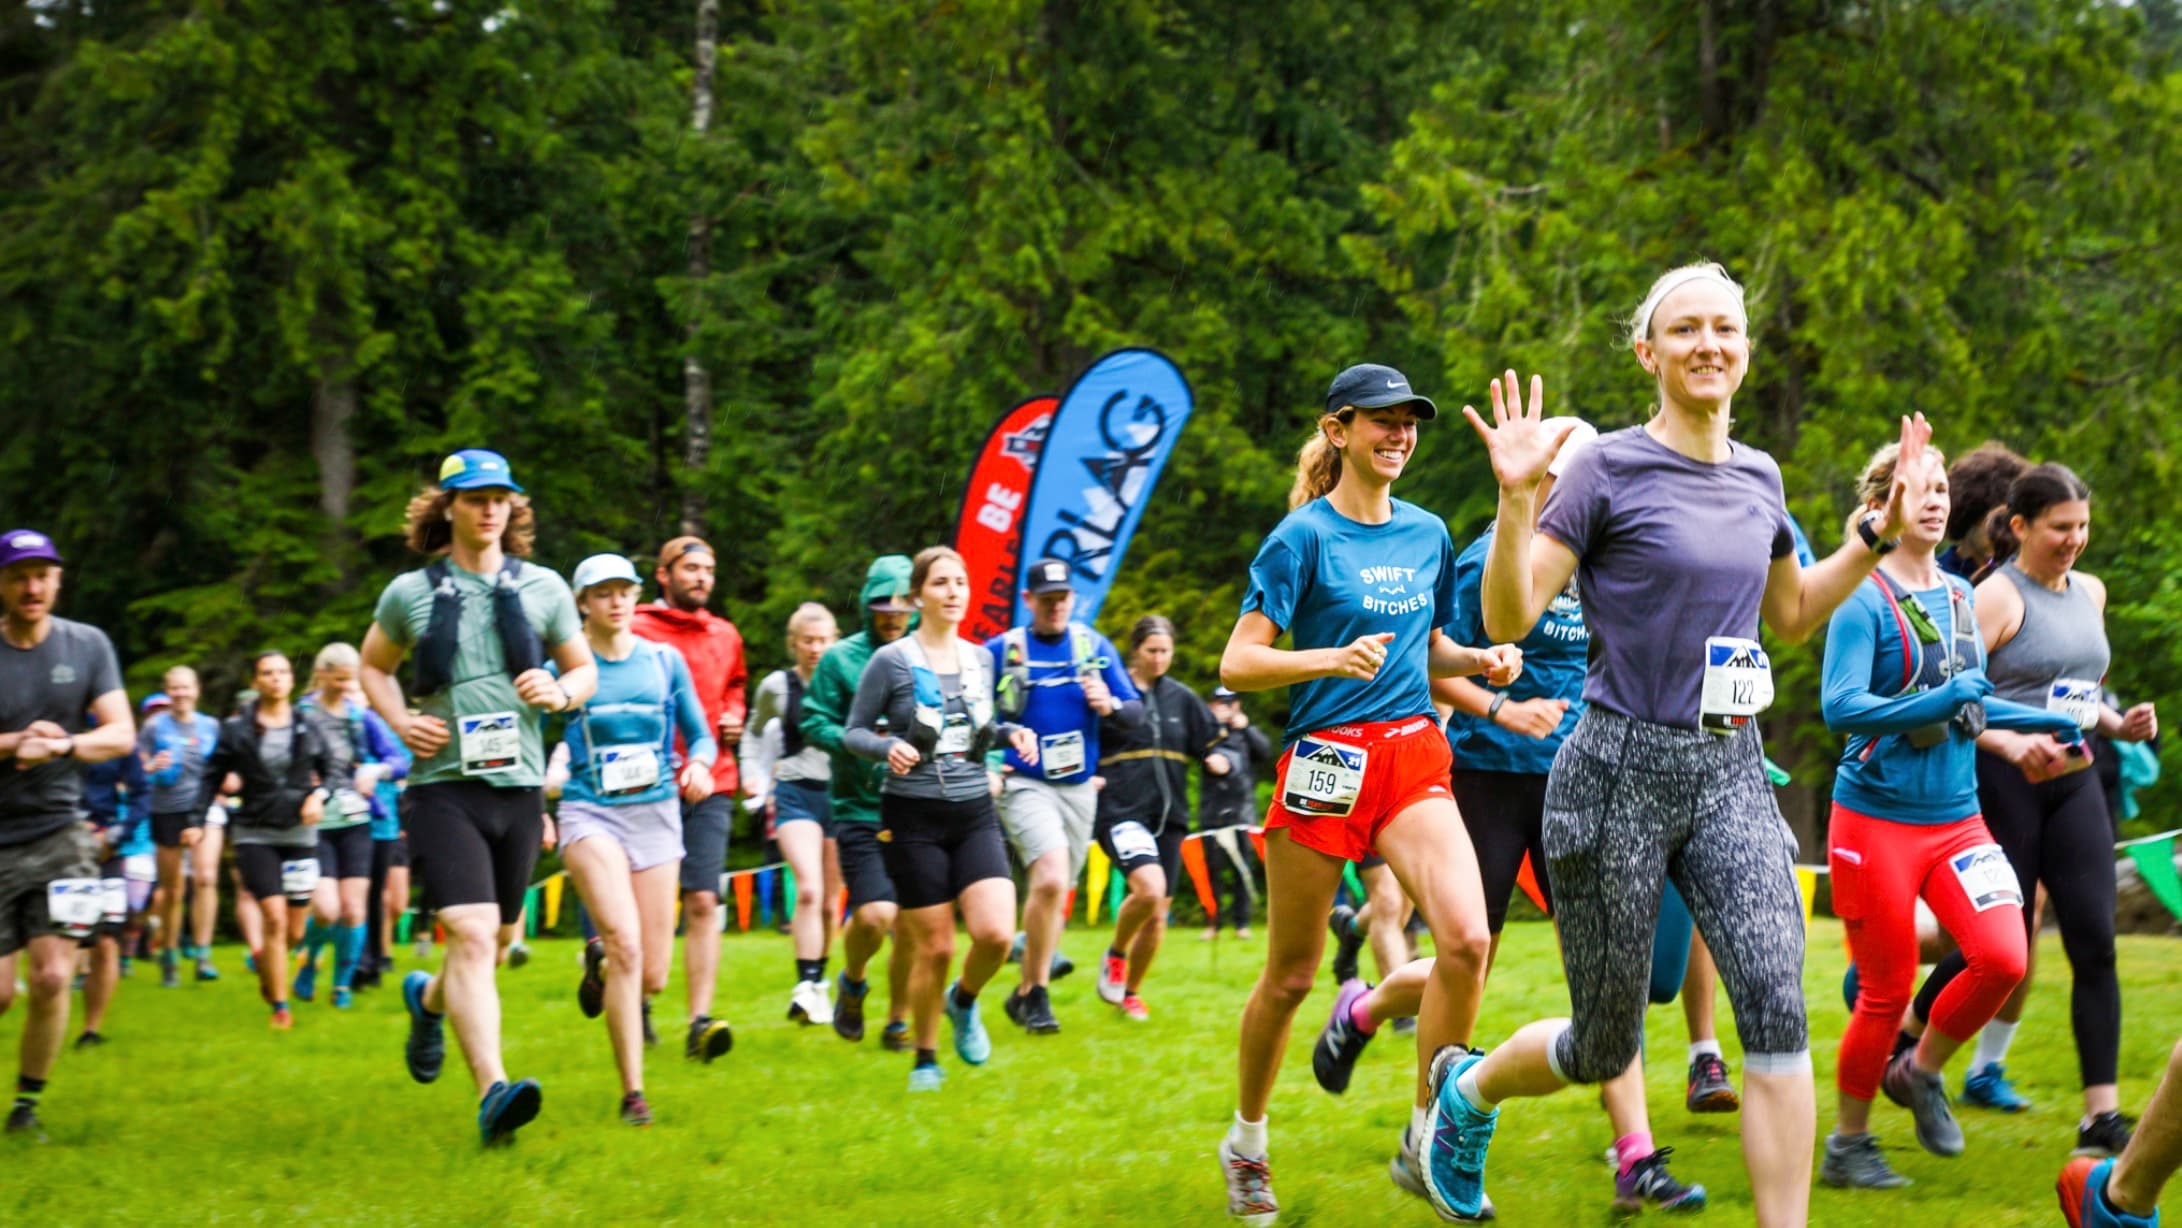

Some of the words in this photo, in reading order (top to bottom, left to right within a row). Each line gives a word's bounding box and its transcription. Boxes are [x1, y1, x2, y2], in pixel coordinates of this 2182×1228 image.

[976, 482, 1022, 533] BE
[1360, 565, 1415, 585] SWIFT
[1363, 593, 1428, 615] BITCHES
[1543, 620, 1590, 642] BITCH
[1732, 679, 1755, 705] 122
[1327, 725, 1364, 738] OOKS
[1348, 756, 1361, 767] 21
[1308, 769, 1337, 795] 159
